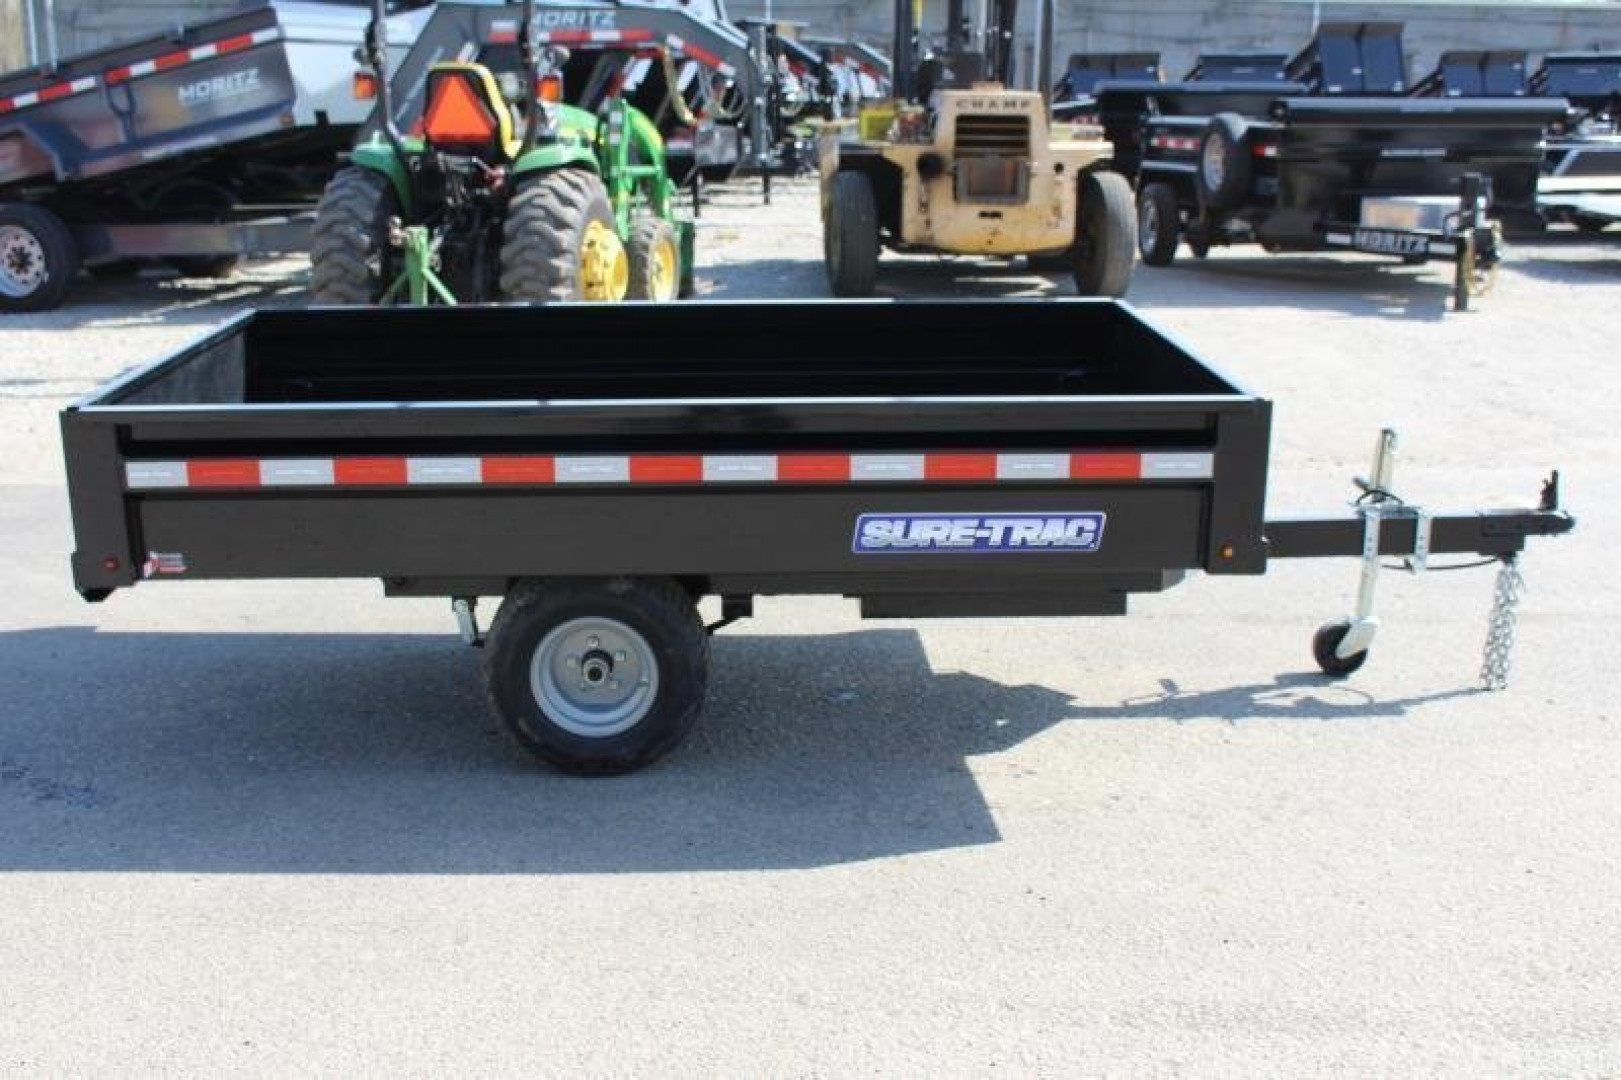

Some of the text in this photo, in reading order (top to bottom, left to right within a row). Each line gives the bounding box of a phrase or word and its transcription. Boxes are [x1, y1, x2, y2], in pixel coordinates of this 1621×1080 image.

[178, 67, 259, 101] MORITZ
[956, 99, 1031, 109] CHAMP
[1354, 230, 1428, 254] MORITZ
[860, 518, 1098, 548] SURE-TRAC
